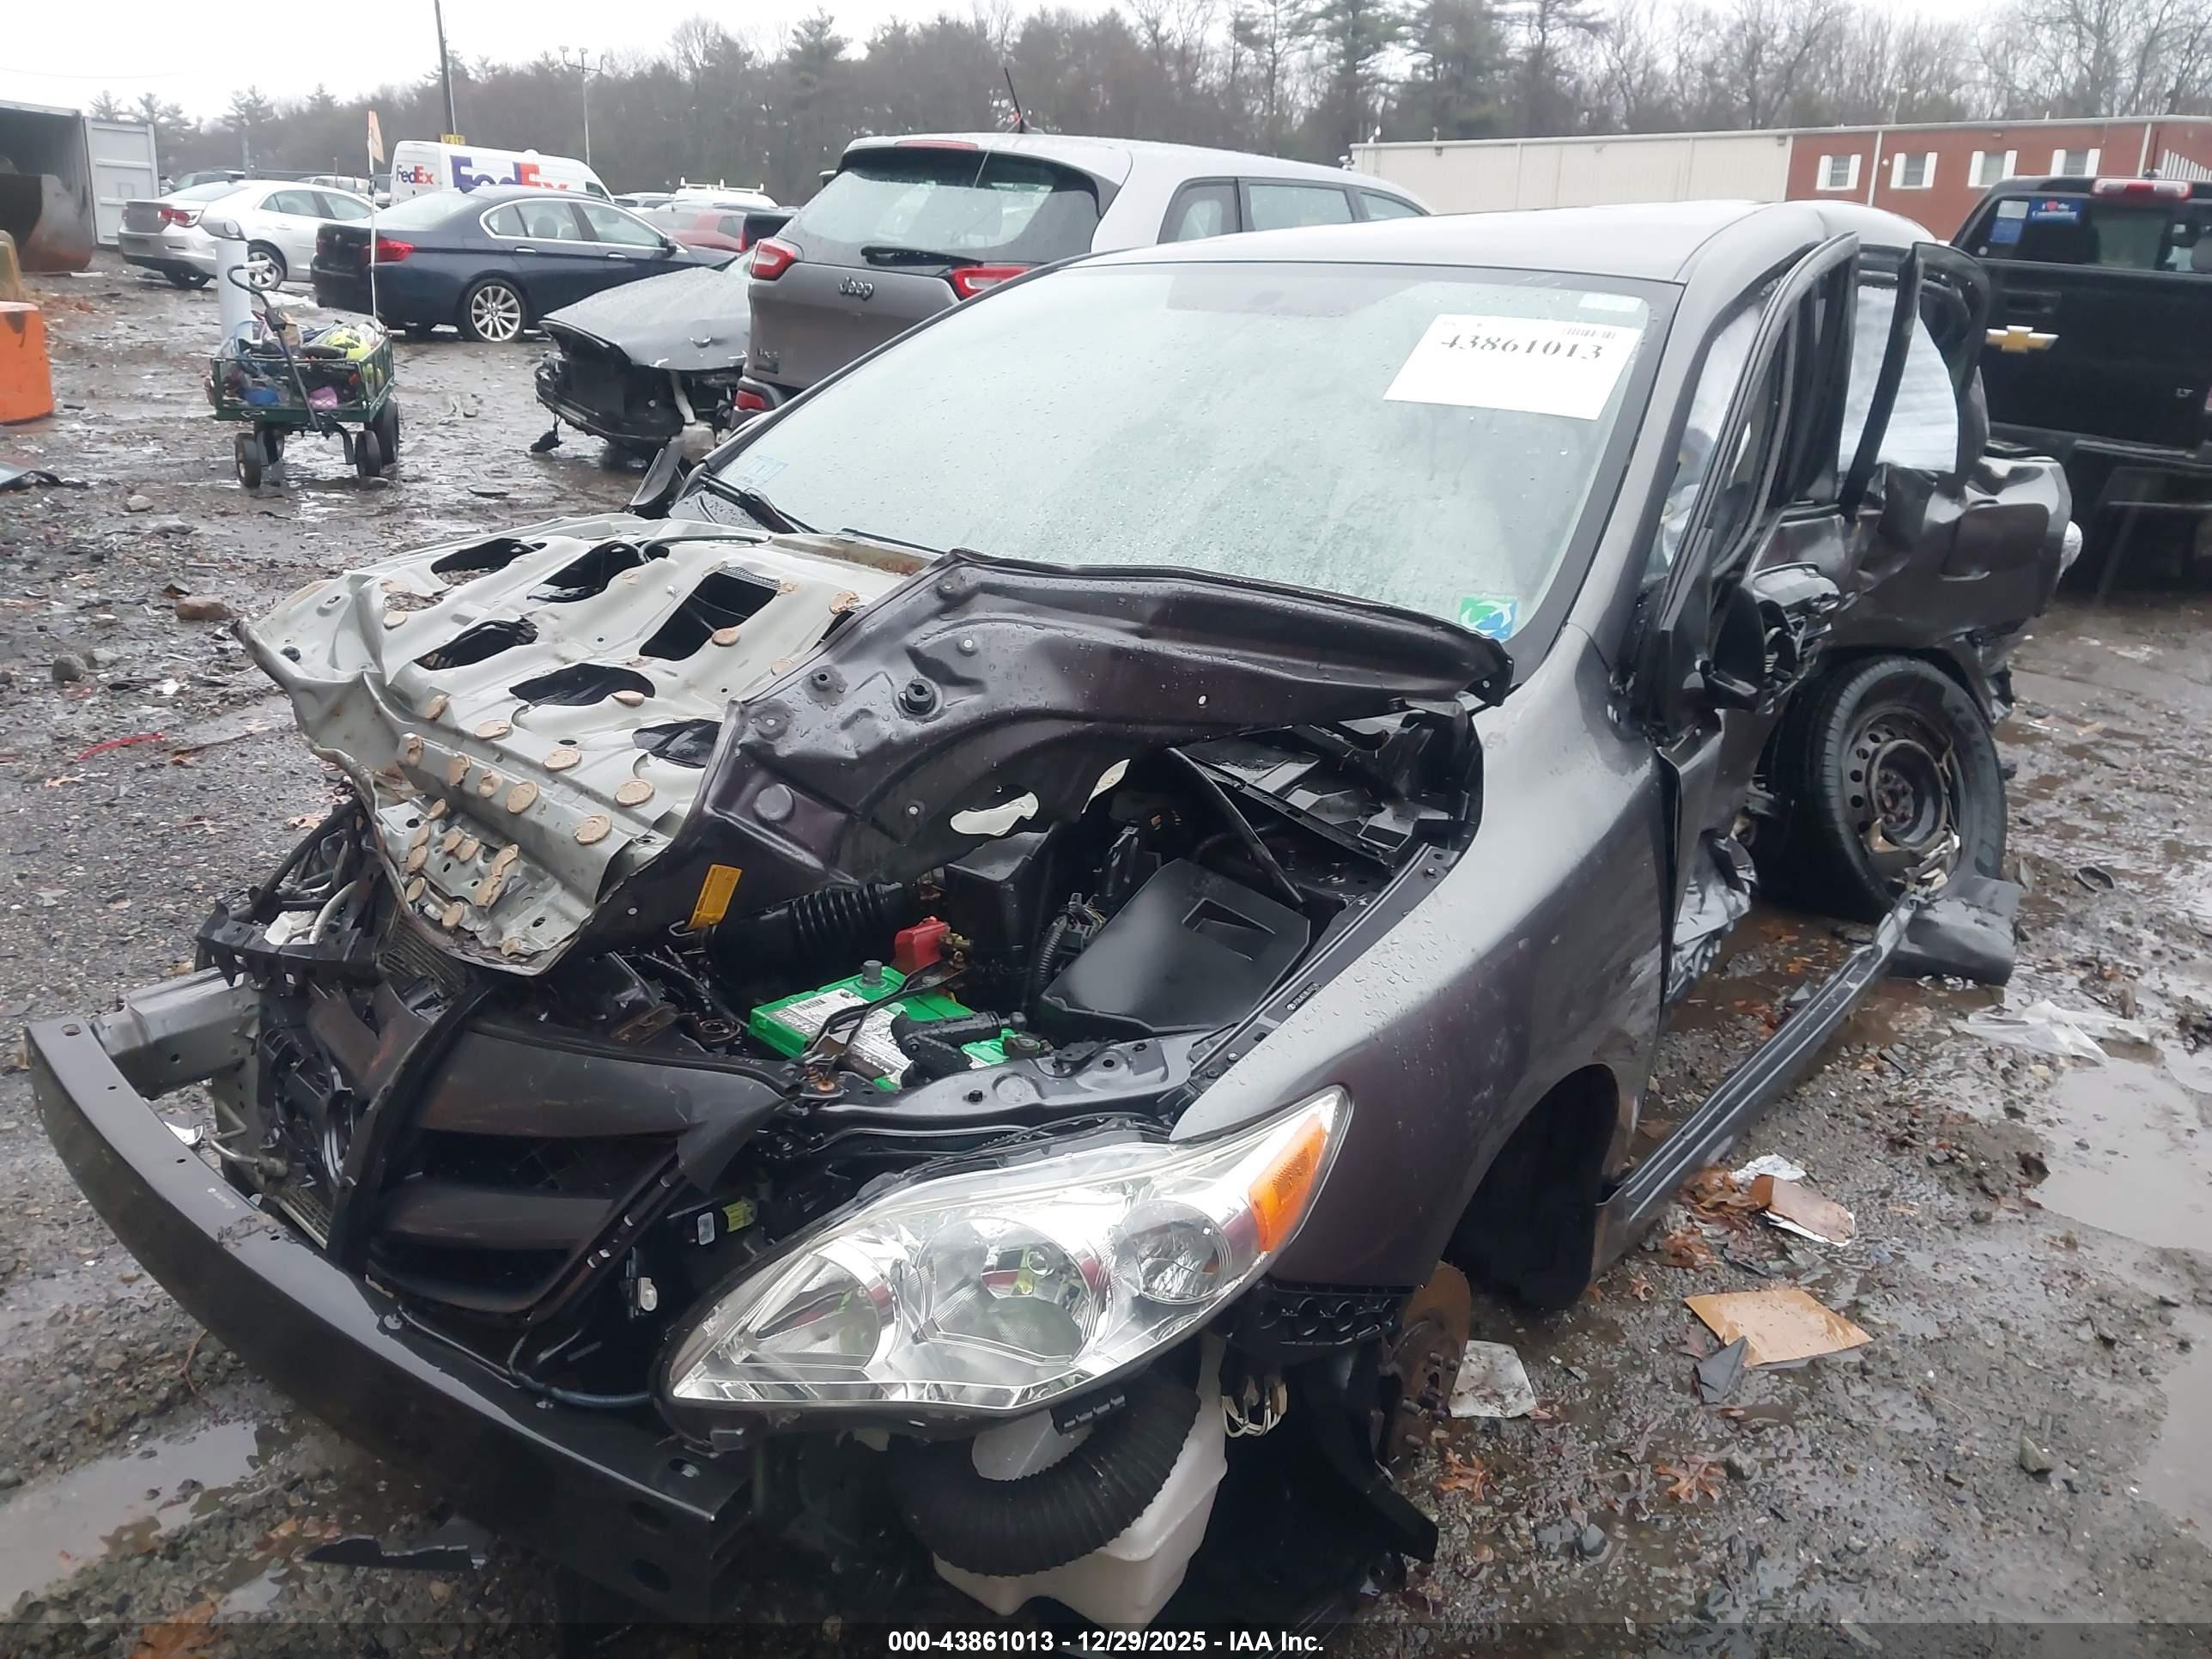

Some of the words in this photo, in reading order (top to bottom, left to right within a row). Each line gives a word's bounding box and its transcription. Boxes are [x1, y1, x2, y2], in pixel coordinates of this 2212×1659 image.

[396, 164, 434, 185] FedEx
[838, 276, 873, 301] Jeep
[1441, 334, 1602, 359] 43861013
